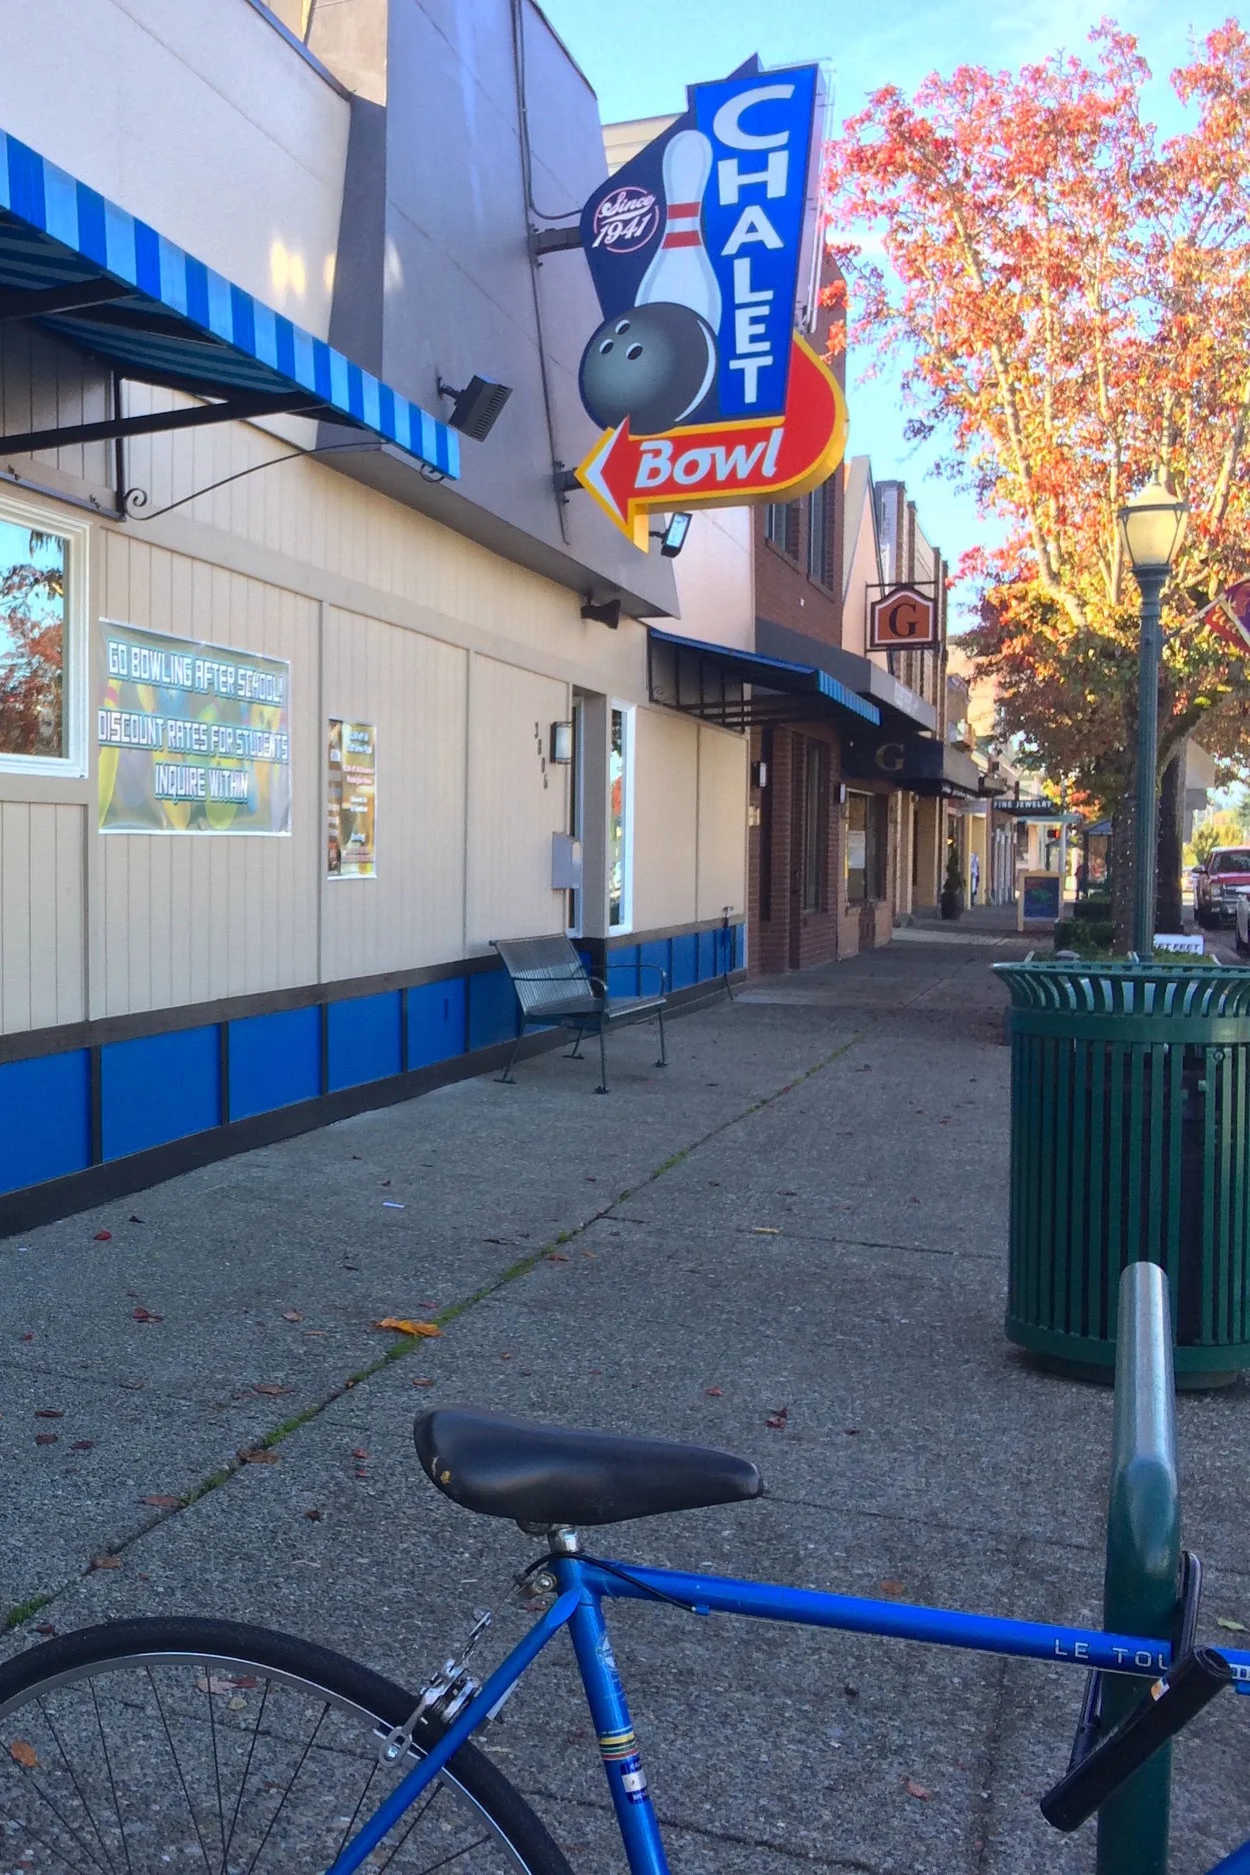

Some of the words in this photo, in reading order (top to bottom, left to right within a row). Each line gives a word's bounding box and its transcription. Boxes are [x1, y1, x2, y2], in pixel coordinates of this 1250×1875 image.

[597, 191, 656, 218] Since
[591, 213, 652, 248] 1941
[713, 84, 796, 404] CHALET
[634, 427, 784, 489] Bowl
[889, 603, 919, 638] G
[108, 641, 128, 675] GO
[131, 646, 193, 687] BOWLING
[195, 660, 236, 695] AFTER
[98, 710, 164, 747] DISCOUNT
[167, 719, 208, 751] RATES
[211, 725, 234, 755] FOR
[236, 731, 288, 760] STUDENTS
[876, 742, 905, 771] G
[155, 763, 206, 800] INQUIRE
[209, 769, 248, 799] WITHIN
[993, 801, 1013, 809] FINE
[1173, 943, 1201, 952] FEET
[1054, 1639, 1089, 1659] LE
